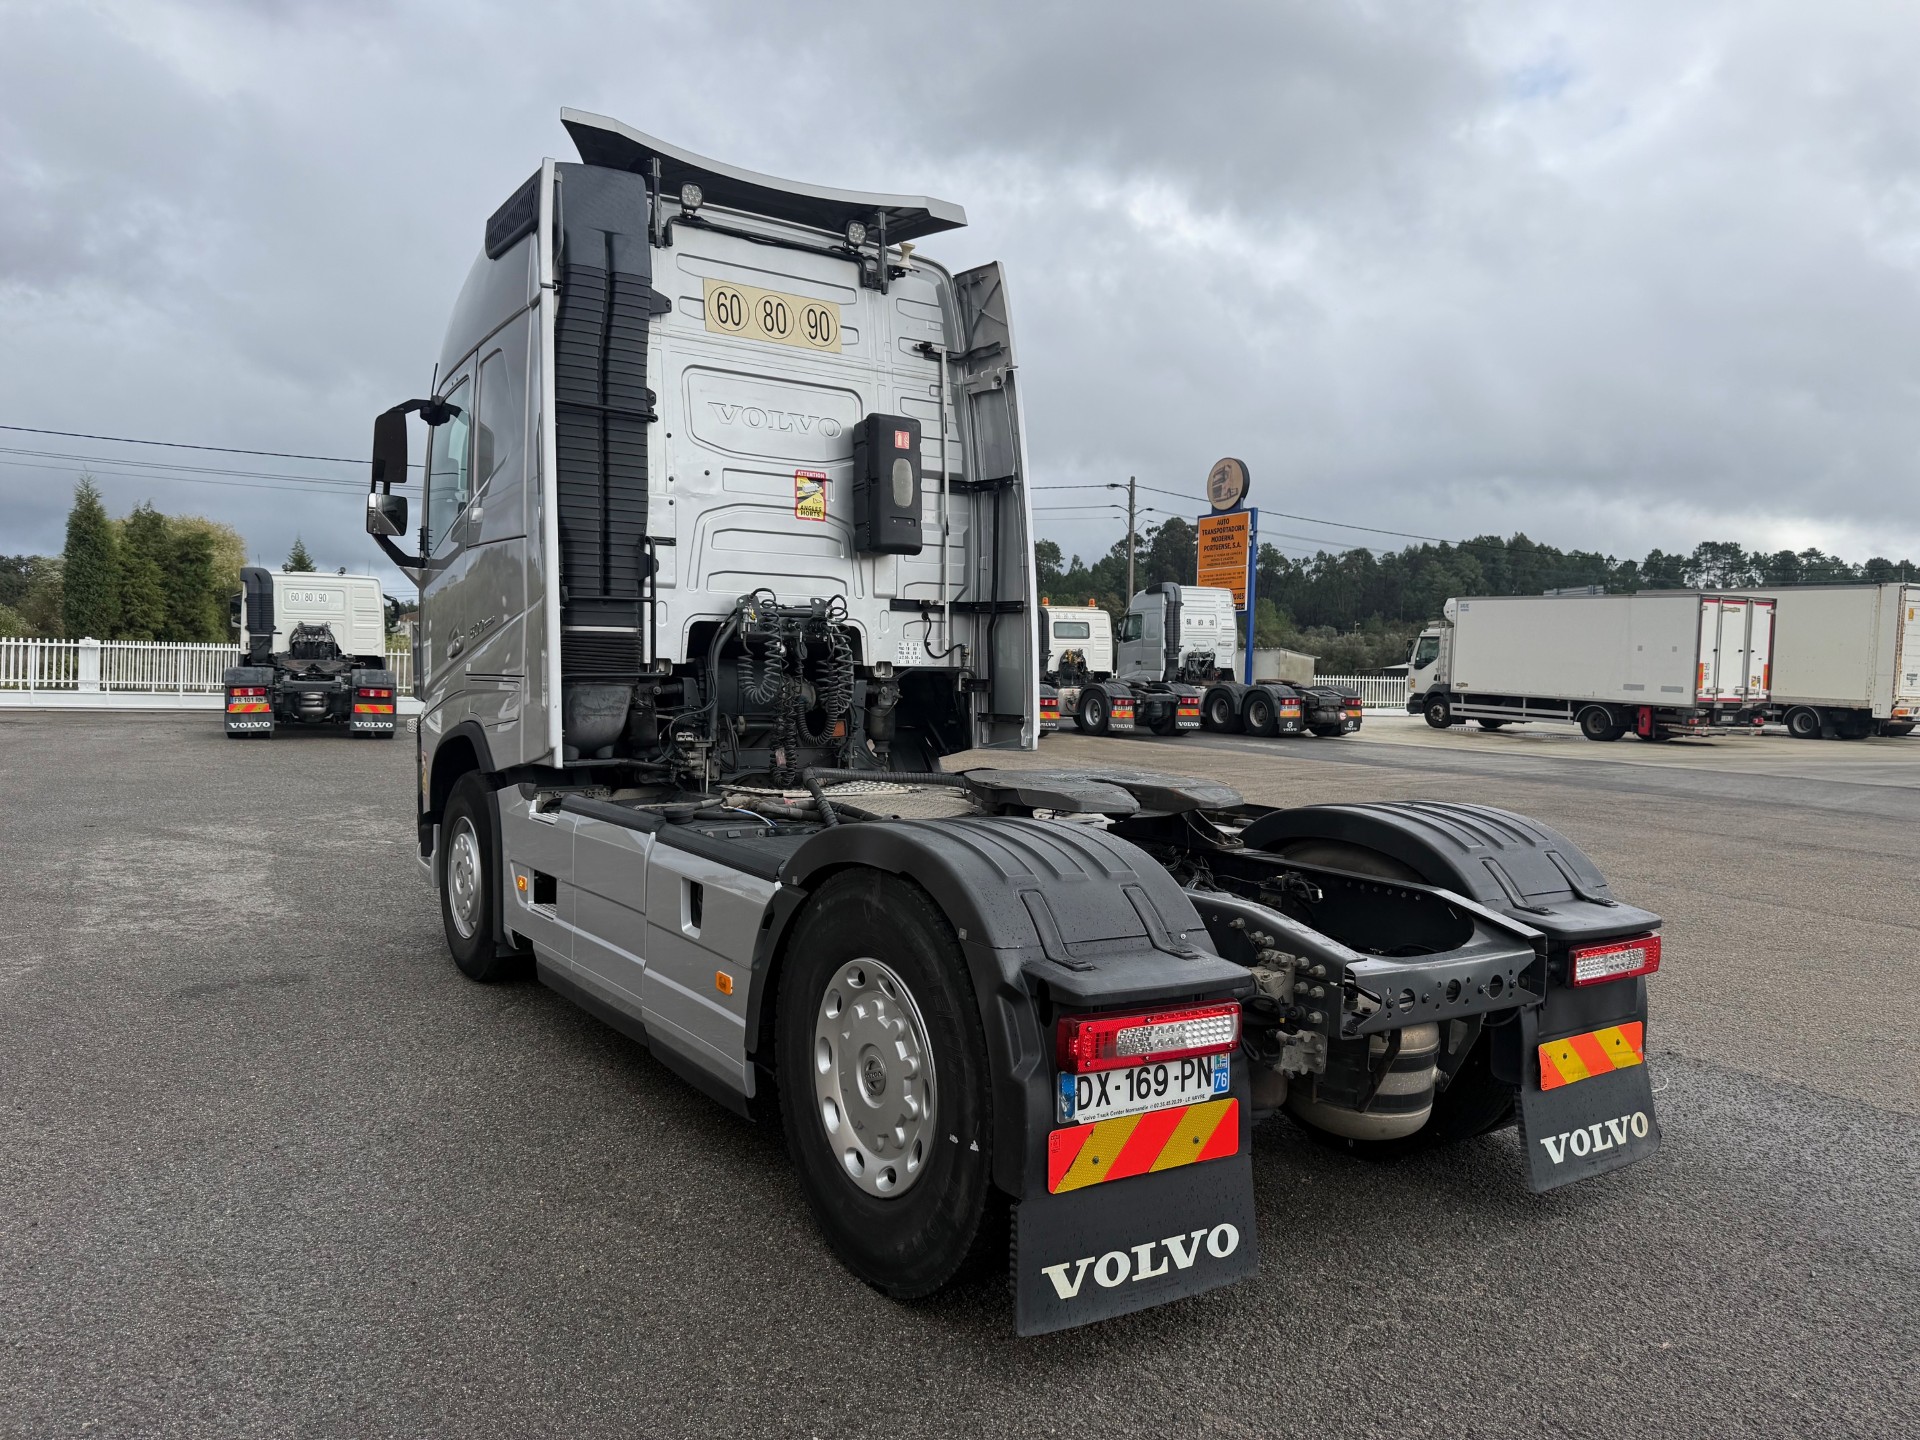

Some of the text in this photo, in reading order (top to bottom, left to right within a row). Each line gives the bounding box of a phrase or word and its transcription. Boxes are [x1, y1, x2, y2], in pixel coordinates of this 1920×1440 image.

[717, 291, 830, 342] 60 80 90
[707, 401, 842, 439] VOLVO
[797, 471, 825, 479] ATTENTION
[1217, 518, 1230, 526] AUTO
[1202, 525, 1245, 536] TRANSPORTADORA
[1211, 534, 1234, 543] MODERNA
[290, 592, 327, 602] 60 80 90
[229, 721, 271, 729] VOLVO
[1215, 1072, 1227, 1088] 76
[1540, 1111, 1649, 1164] VOLVO
[1041, 1223, 1240, 1300] VOLVO
